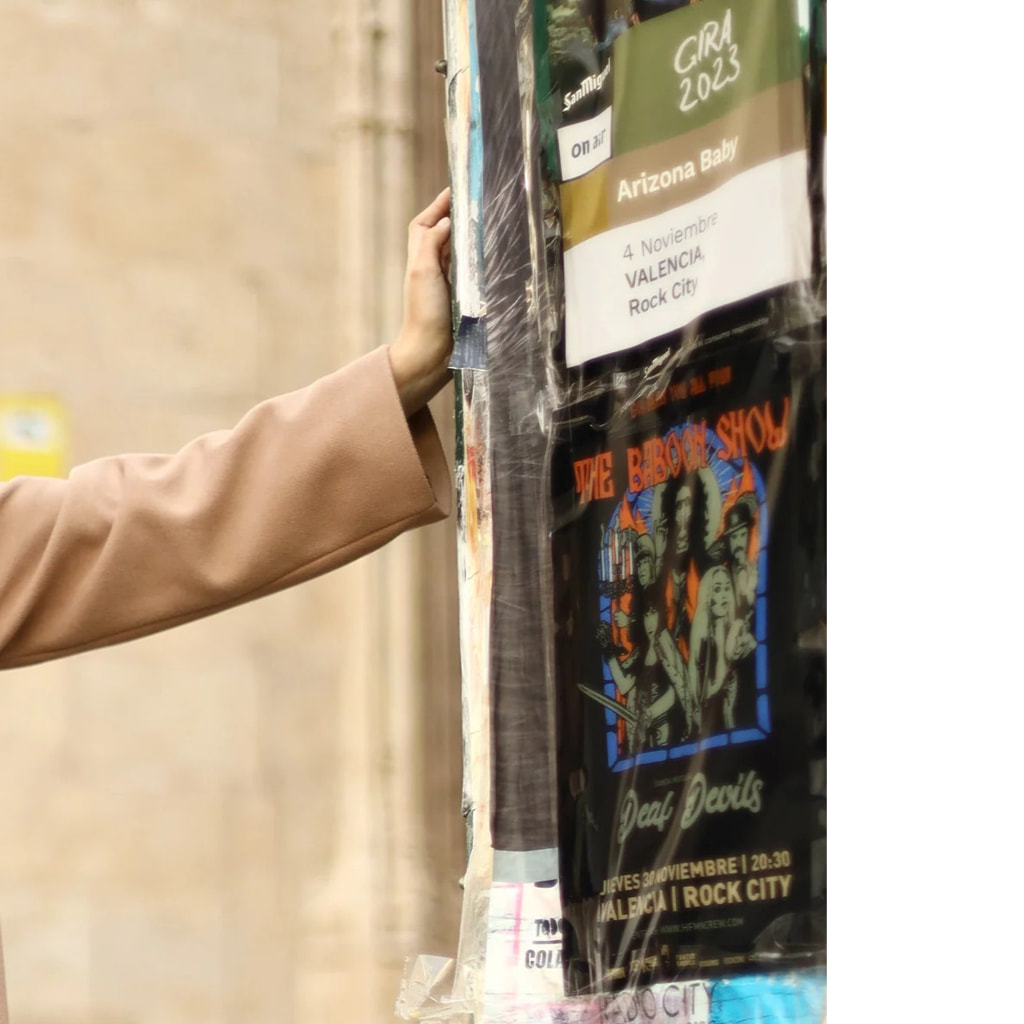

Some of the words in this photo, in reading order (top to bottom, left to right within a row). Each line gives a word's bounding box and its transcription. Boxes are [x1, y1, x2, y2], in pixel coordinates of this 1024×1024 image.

[674, 8, 732, 74] GIRA
[679, 43, 740, 112] 2023
[571, 140, 590, 159] on
[593, 129, 607, 150] air
[617, 161, 696, 203] Arizona
[700, 136, 739, 173] Baby
[622, 243, 634, 261] 4
[641, 212, 719, 257] Noviembre
[628, 288, 668, 317] Rock
[671, 277, 699, 300] City
[574, 451, 615, 504] THE
[626, 420, 708, 494] BABOON
[716, 396, 792, 462] SHOW
[617, 788, 675, 846] Deaf
[680, 769, 765, 831] Devils
[751, 850, 792, 872] 20:30
[682, 880, 742, 909] ROCK
[746, 875, 793, 901] CITY
[662, 982, 717, 1018] CITY
